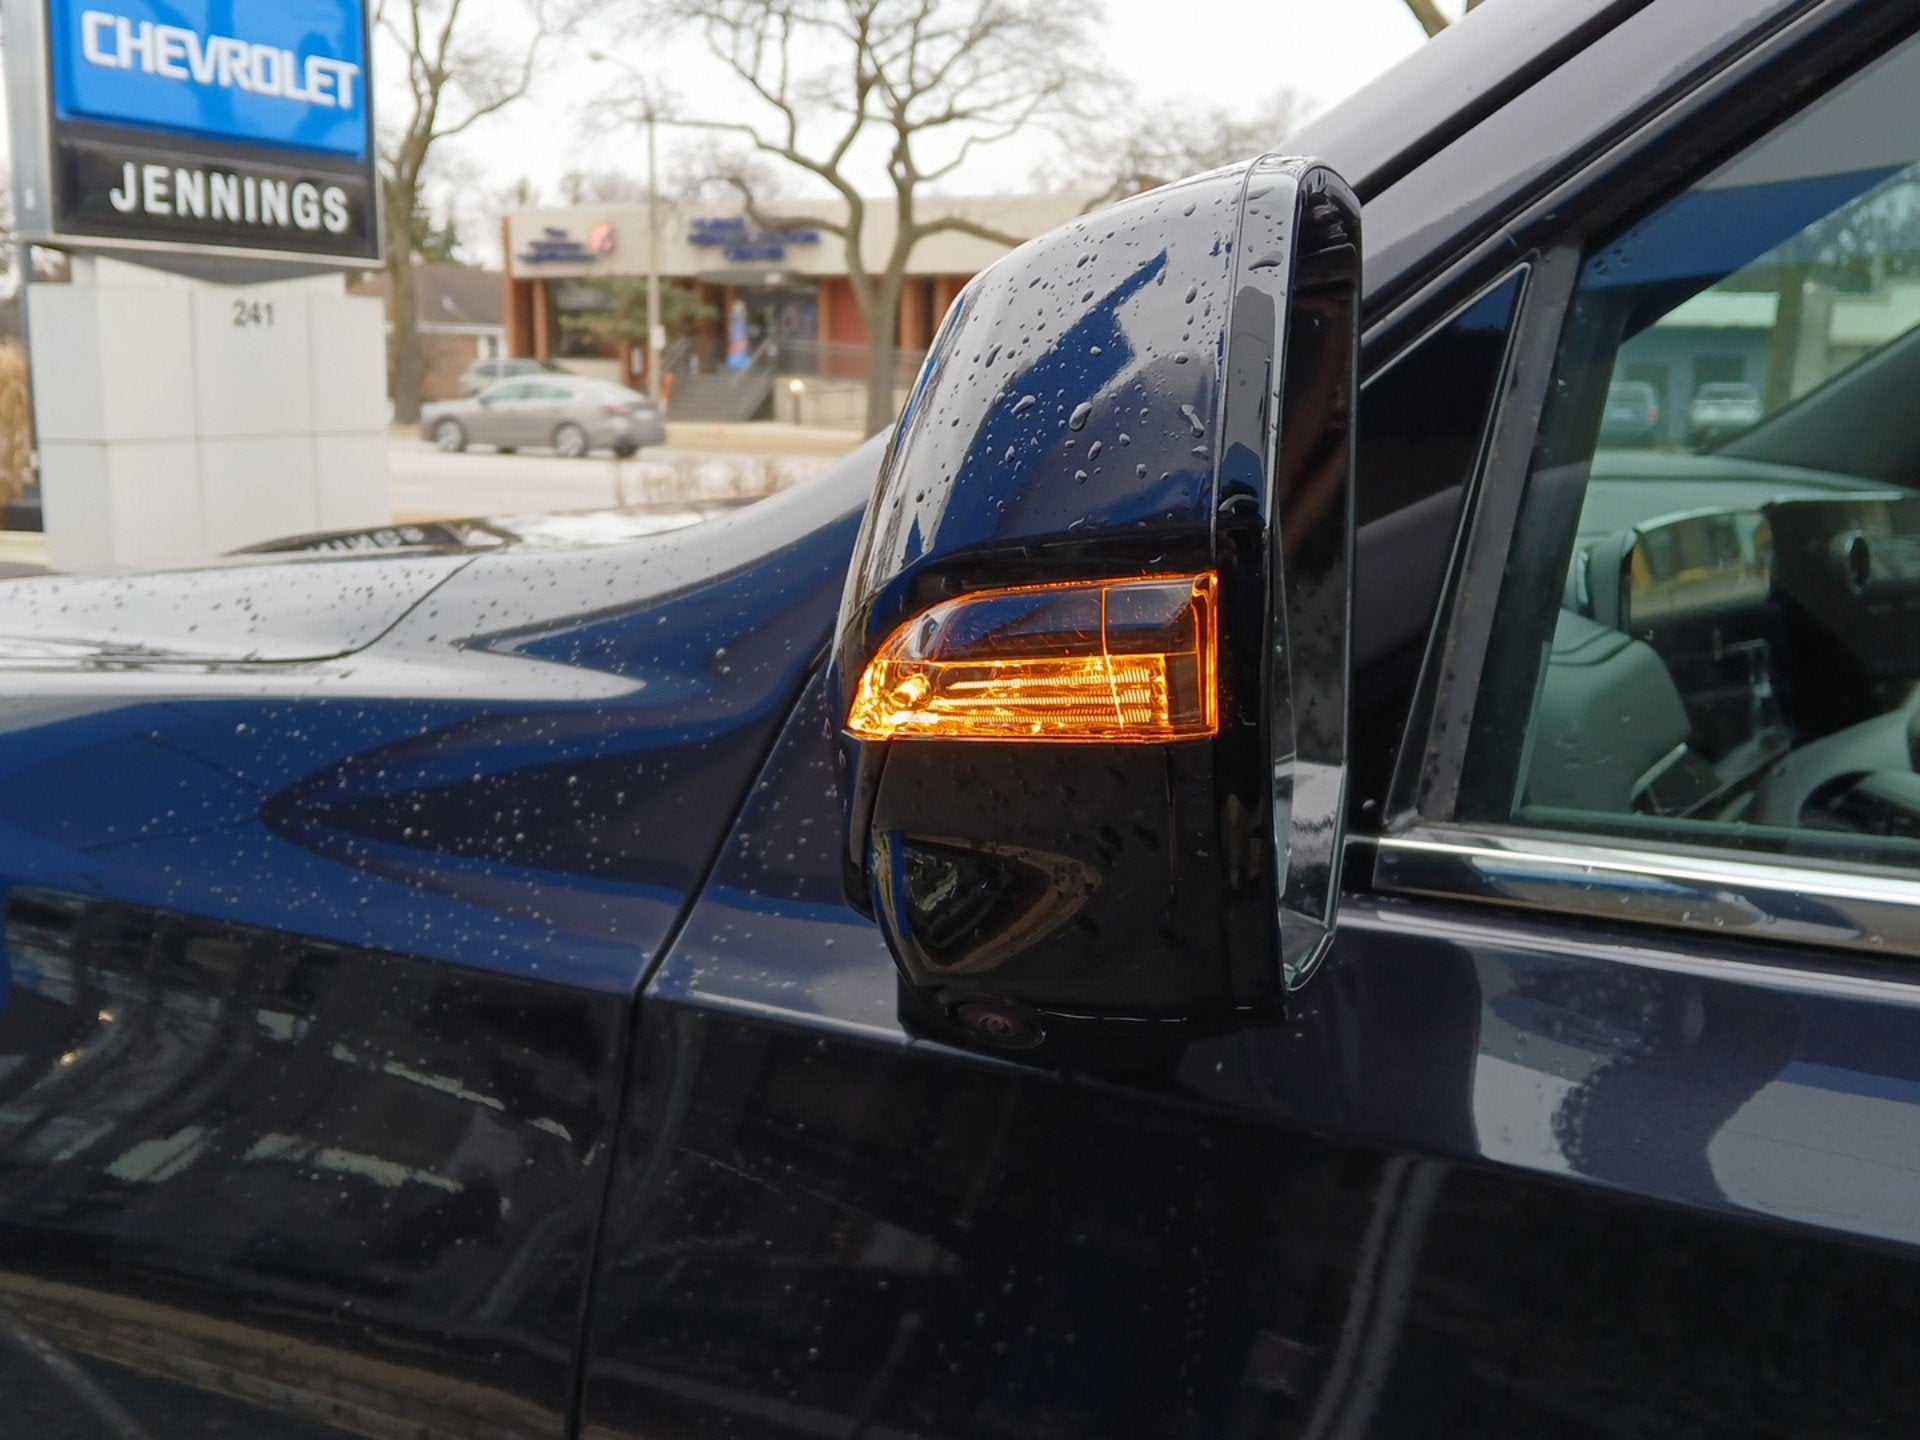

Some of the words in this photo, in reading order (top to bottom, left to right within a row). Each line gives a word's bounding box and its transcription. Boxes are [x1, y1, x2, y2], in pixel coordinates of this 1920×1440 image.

[81, 10, 359, 109] CHEVROLET
[109, 162, 349, 234] JENNINGS
[232, 300, 275, 327] 241
